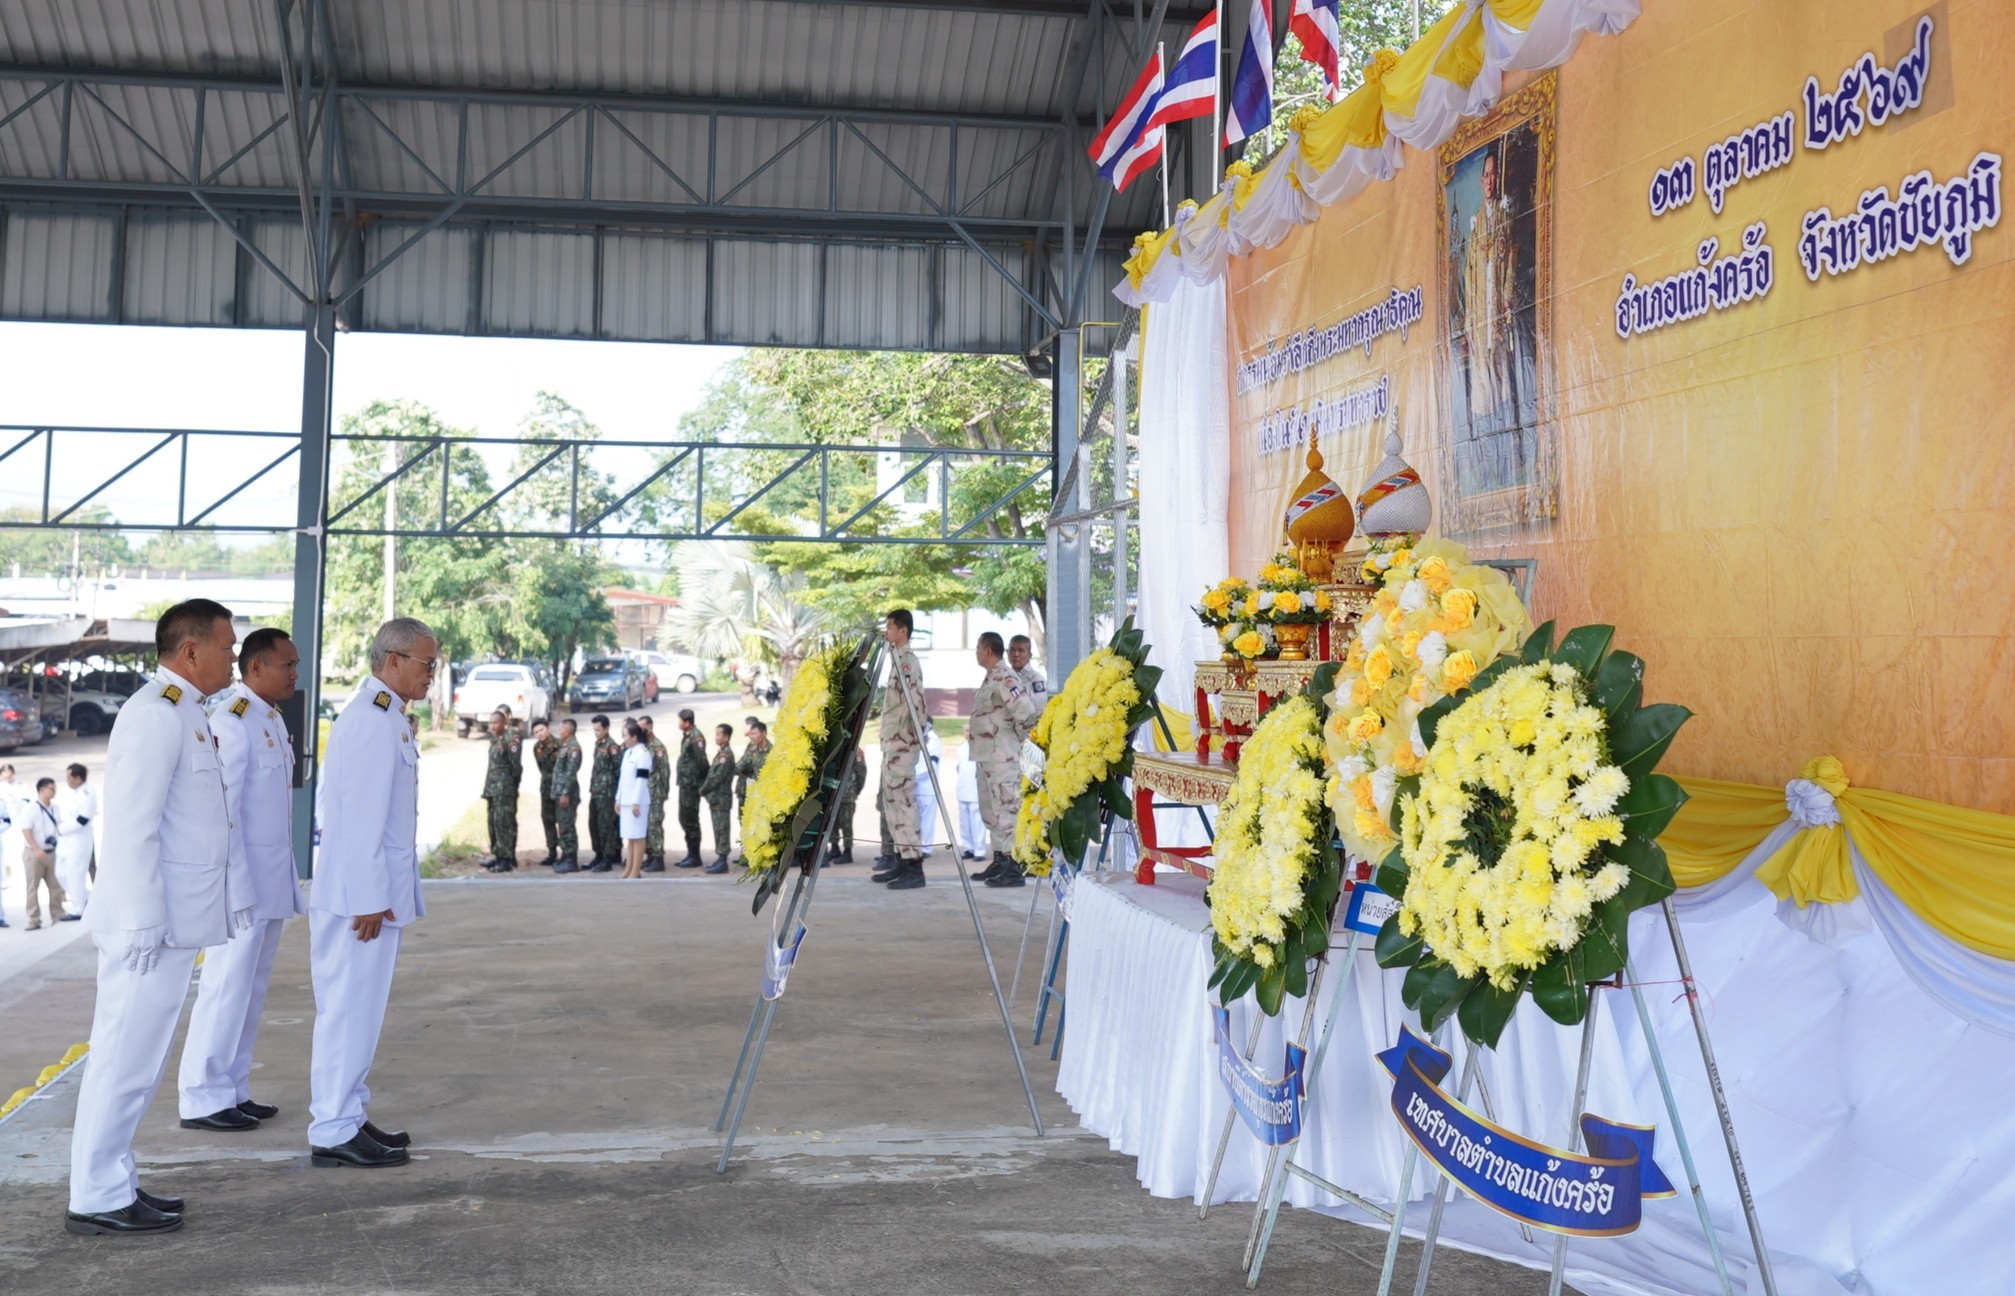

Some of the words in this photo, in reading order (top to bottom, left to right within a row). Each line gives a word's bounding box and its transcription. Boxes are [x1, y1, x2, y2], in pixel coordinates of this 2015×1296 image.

[1651, 160, 1693, 211] ๑๓
[1706, 116, 1791, 208] ตุลาคม
[1806, 22, 1930, 144] ๒๕๖๗
[1617, 226, 1770, 333] อำเภอแก้งคร้อ
[1802, 158, 1997, 275] จังหวัดชัยภูมิ
[1405, 1091, 1615, 1215] เทศบาลตำบลแก้งคร้อ
